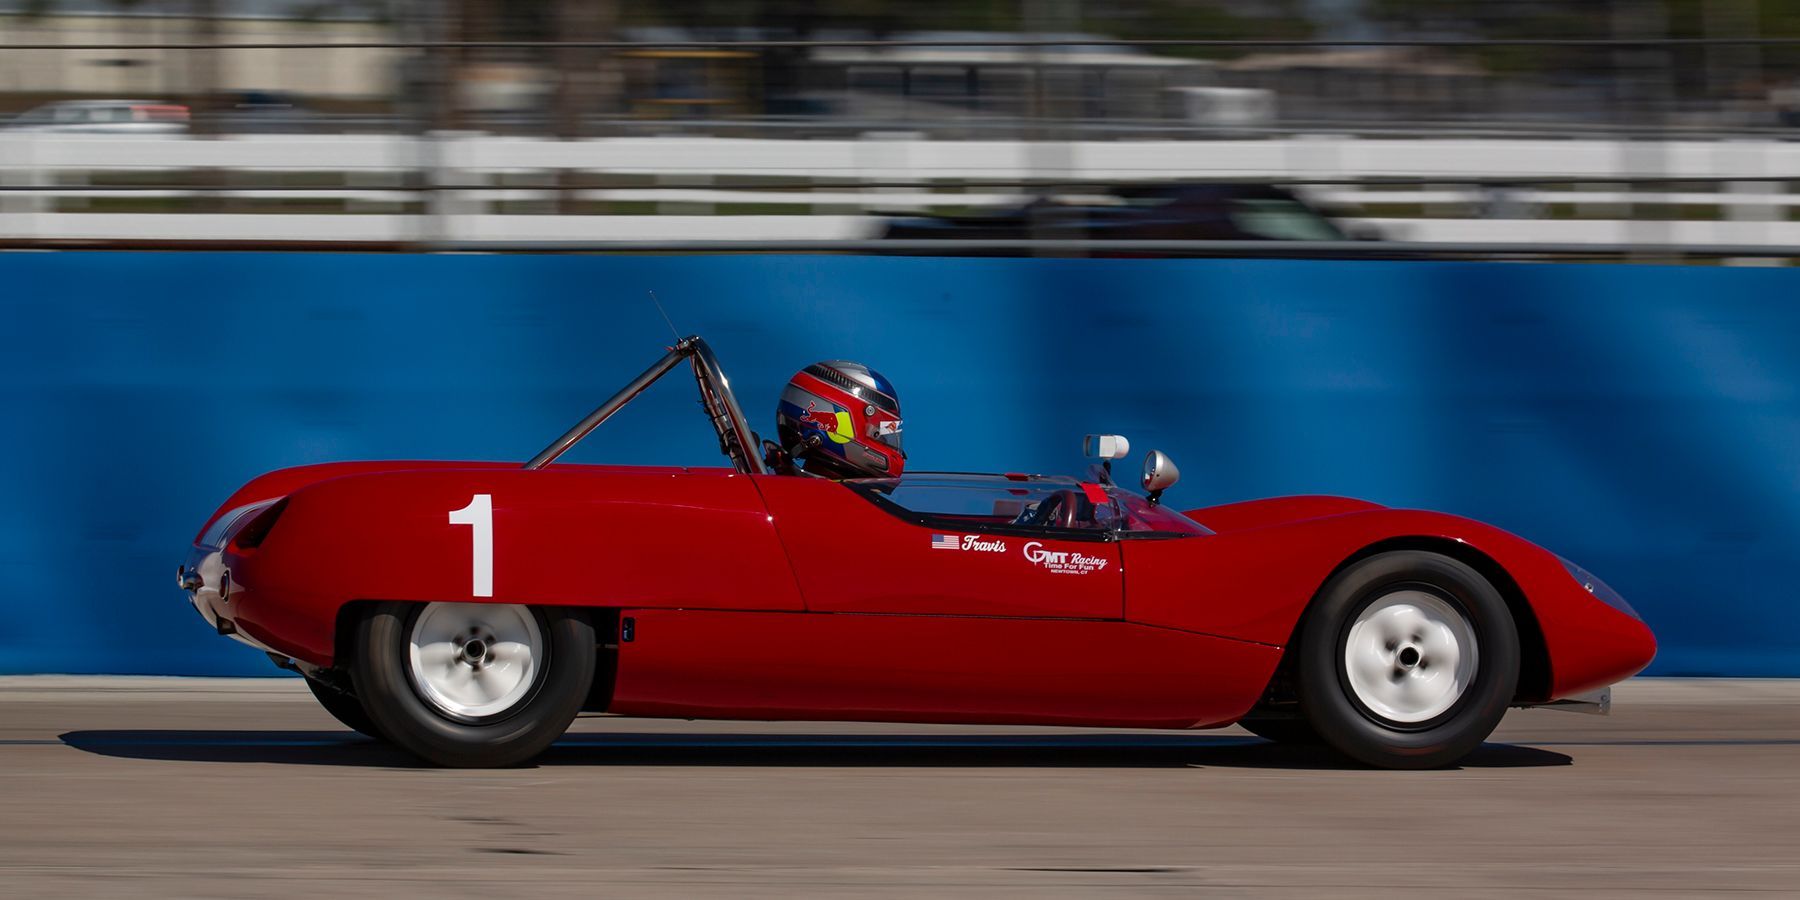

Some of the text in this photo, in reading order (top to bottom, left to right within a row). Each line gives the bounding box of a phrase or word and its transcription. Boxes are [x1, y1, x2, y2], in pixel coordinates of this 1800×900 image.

[448, 494, 493, 597] 1
[961, 535, 1006, 552] Travis
[1070, 552, 1108, 570] Racing
